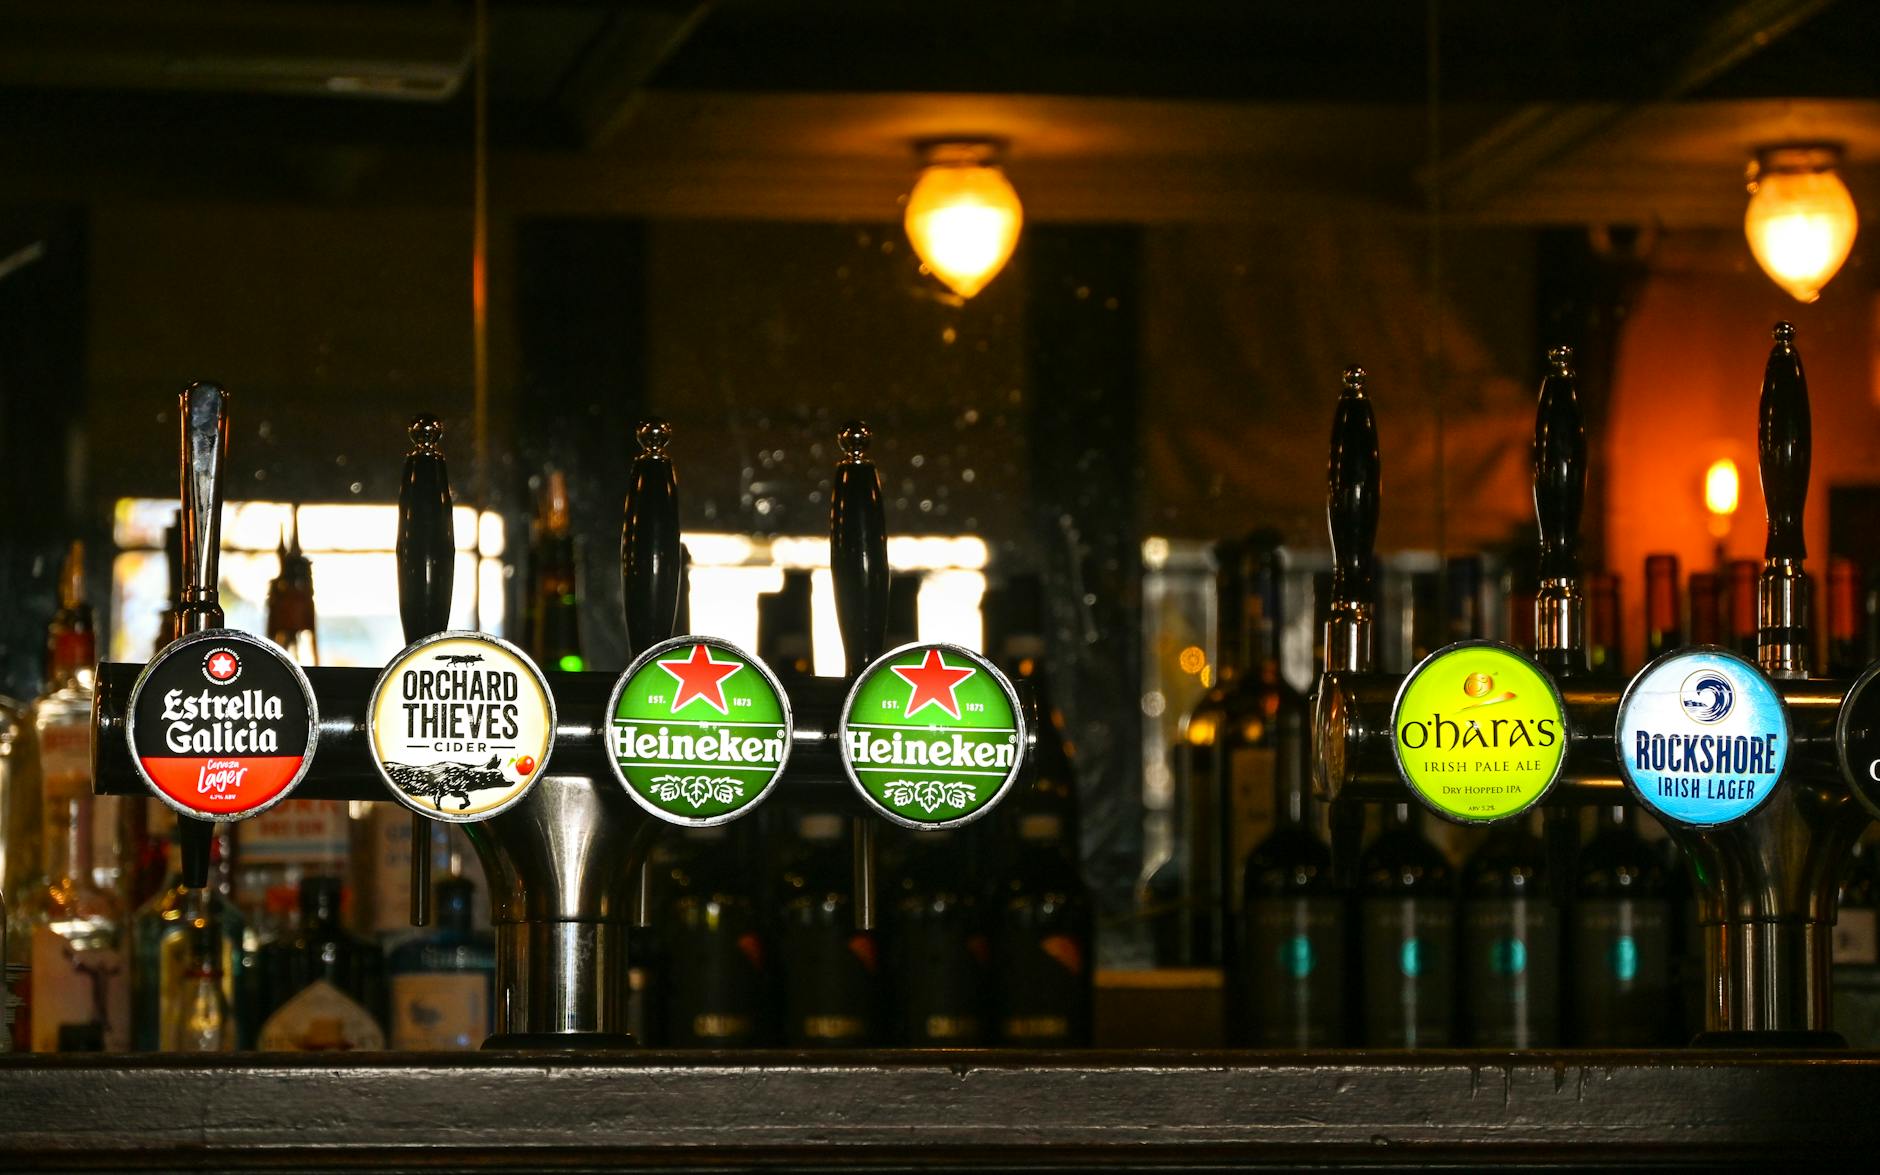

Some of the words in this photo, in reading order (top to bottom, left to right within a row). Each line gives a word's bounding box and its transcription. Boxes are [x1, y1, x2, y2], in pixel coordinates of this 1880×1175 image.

[402, 669, 518, 702] ORCHARD
[161, 688, 284, 720] Estrella
[647, 695, 666, 704] EST.
[733, 697, 752, 707] 1873
[881, 700, 900, 709] EST.
[402, 703, 519, 740] THIEVES
[166, 720, 278, 753] Galicia
[434, 742, 487, 752] CIDER
[612, 725, 784, 762] Heineken
[846, 731, 1015, 767] Heineken
[207, 759, 240, 770] Cerveza
[1636, 730, 1777, 774] ROCKSHORE
[197, 766, 248, 793] Lager
[1424, 761, 1467, 772] IRISH
[1475, 761, 1510, 772] PALE
[1516, 760, 1541, 771] ALE
[1506, 785, 1521, 793] IPA
[1658, 777, 1700, 798] IRISH
[1708, 779, 1755, 799] LAGER
